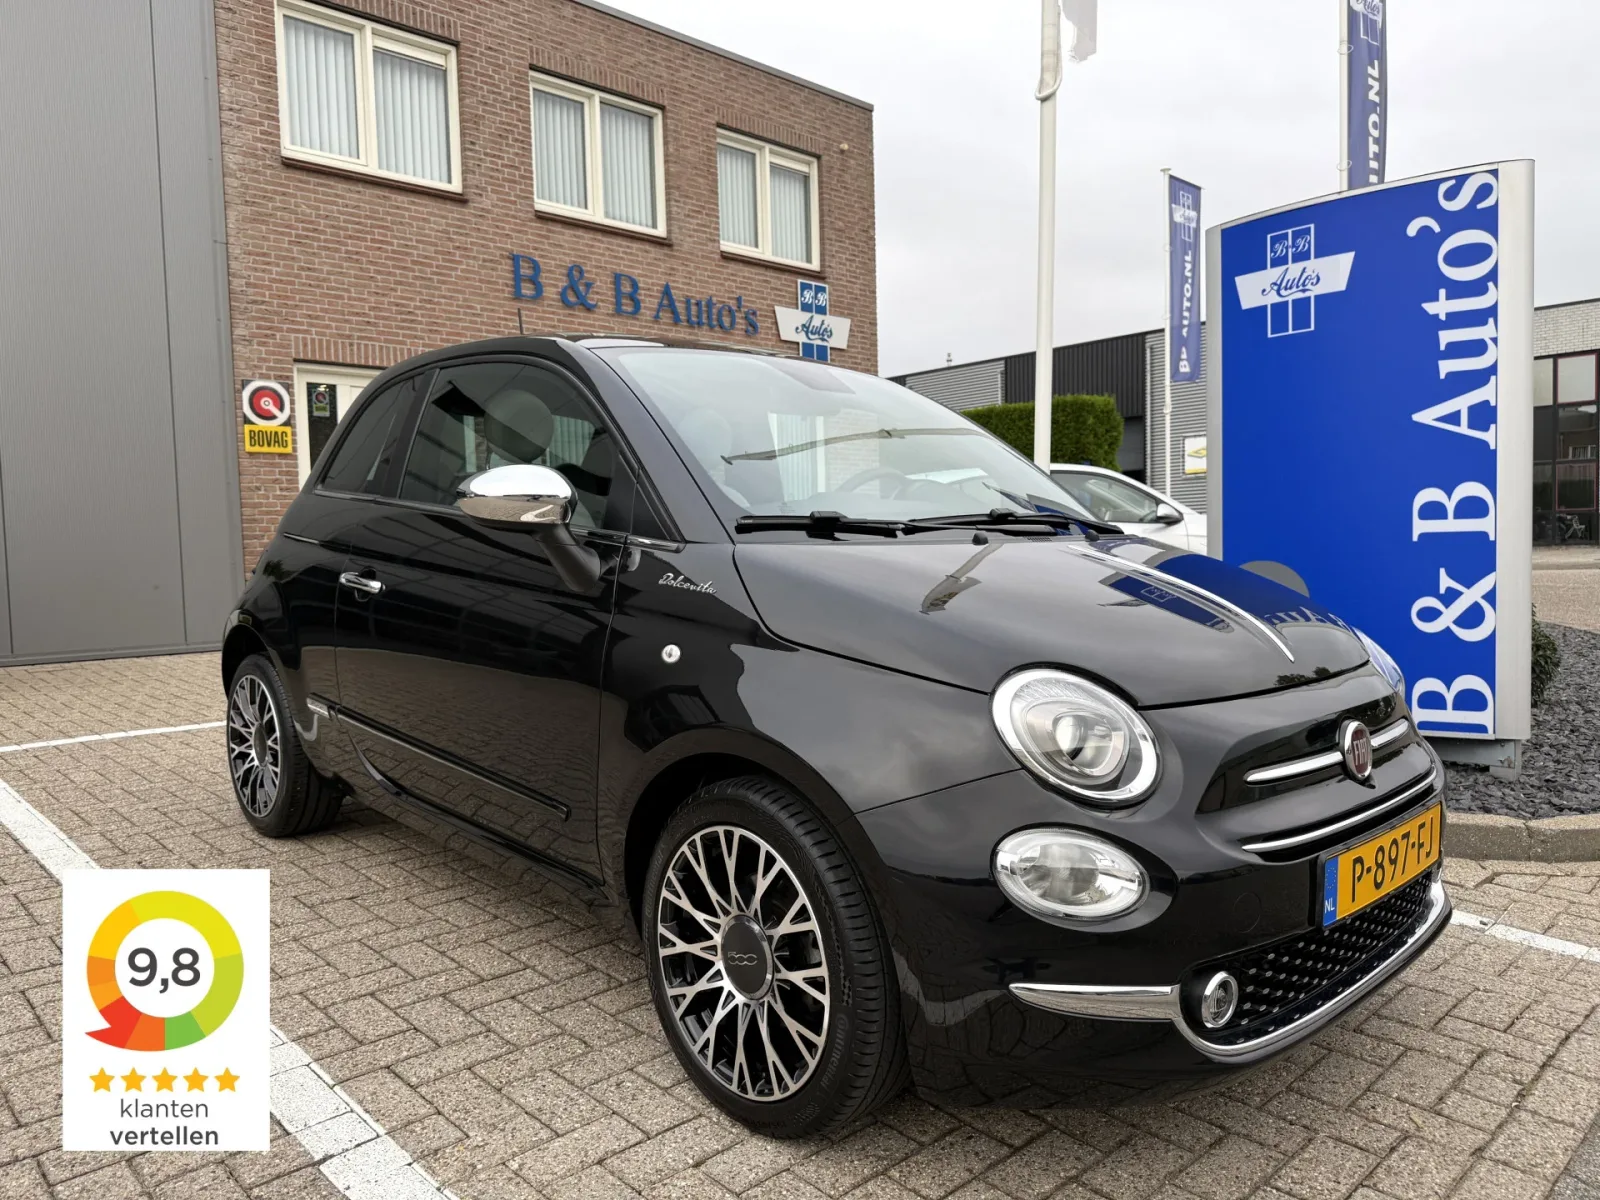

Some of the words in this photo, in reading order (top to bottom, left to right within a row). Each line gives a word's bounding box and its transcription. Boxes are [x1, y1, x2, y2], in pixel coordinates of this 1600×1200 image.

[509, 252, 544, 300] B
[560, 263, 598, 311] &
[613, 272, 642, 316] B
[654, 281, 760, 336] Auto's
[1261, 266, 1321, 298] Auto's
[1406, 172, 1499, 450] Auto's
[795, 314, 833, 344] Auto's
[249, 429, 288, 449] BOVAG
[1412, 481, 1496, 542] B
[658, 572, 717, 594] Dolcevita
[1410, 567, 1496, 642] &
[1412, 674, 1494, 733] B
[1353, 737, 1370, 765] FIAT
[1351, 814, 1434, 903] P-897-FJ
[1324, 899, 1335, 914] NL
[727, 951, 758, 966] 500
